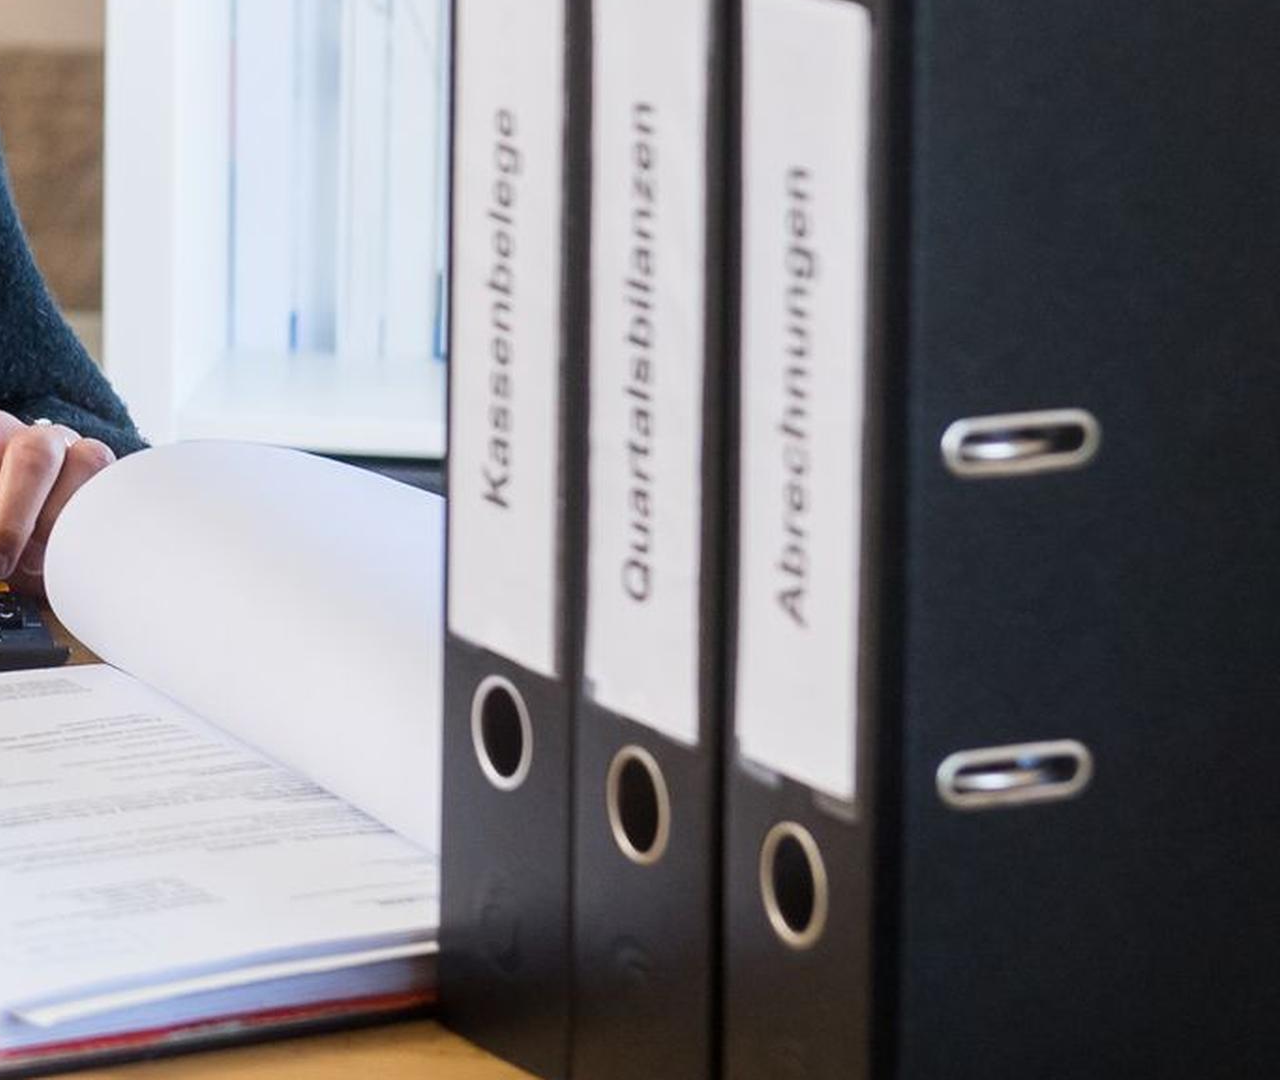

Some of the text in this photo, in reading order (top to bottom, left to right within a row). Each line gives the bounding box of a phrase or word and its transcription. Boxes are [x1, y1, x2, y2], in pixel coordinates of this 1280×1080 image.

[481, 107, 524, 511] Kassenbelege
[622, 101, 658, 606] Quartalsbilanzen
[775, 166, 820, 628] Abrechnungen
